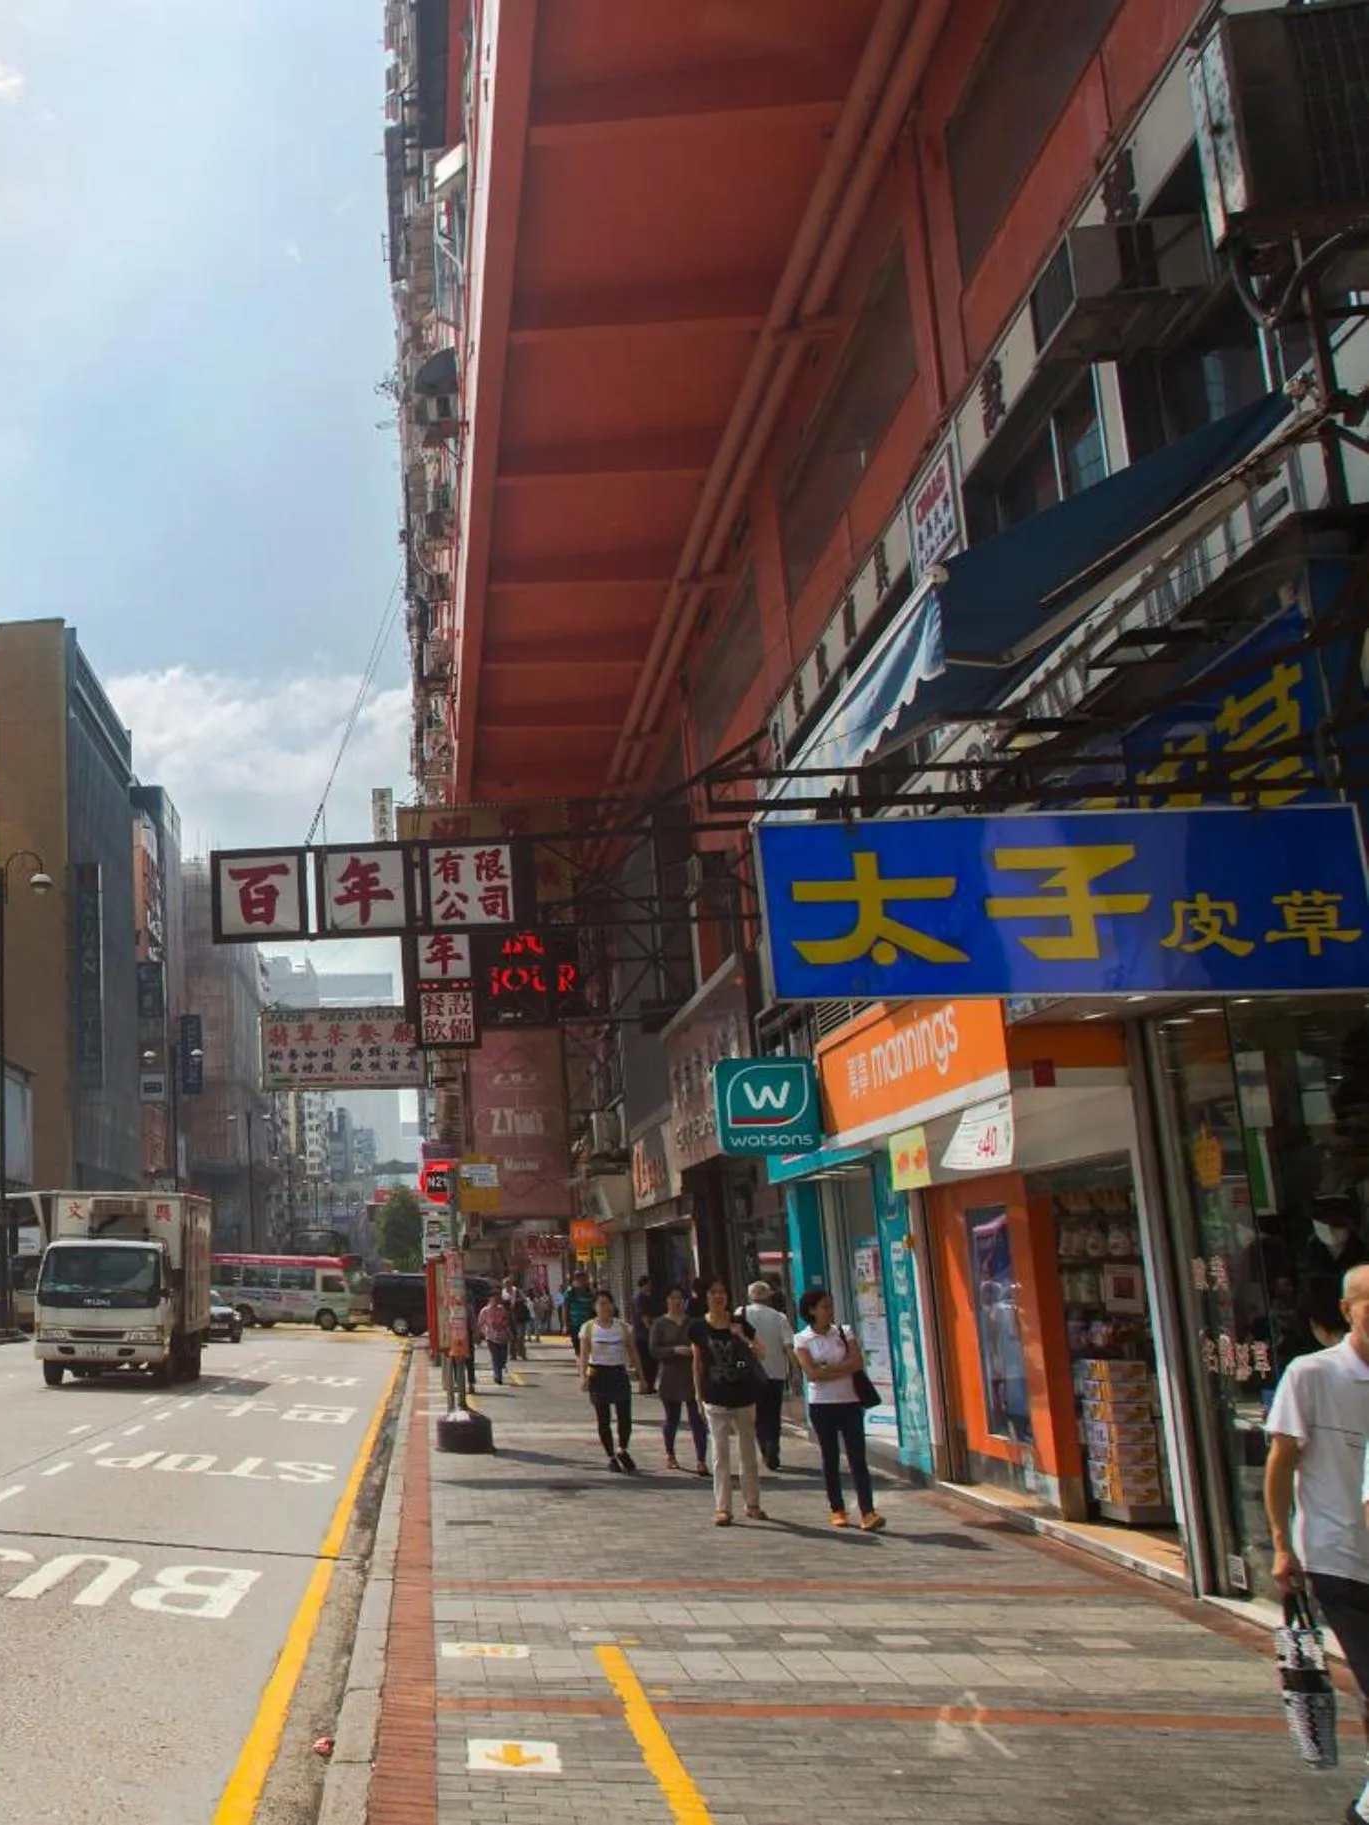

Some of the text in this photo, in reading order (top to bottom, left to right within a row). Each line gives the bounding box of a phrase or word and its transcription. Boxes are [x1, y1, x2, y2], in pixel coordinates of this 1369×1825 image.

[432, 847, 510, 884] 有限
[227, 855, 395, 926] 百年
[433, 885, 511, 922] 公司
[791, 844, 1363, 966] 太子皮草
[871, 1003, 959, 1090] mannings
[730, 1131, 814, 1147] watsons
[94, 1450, 337, 1483] STOP
